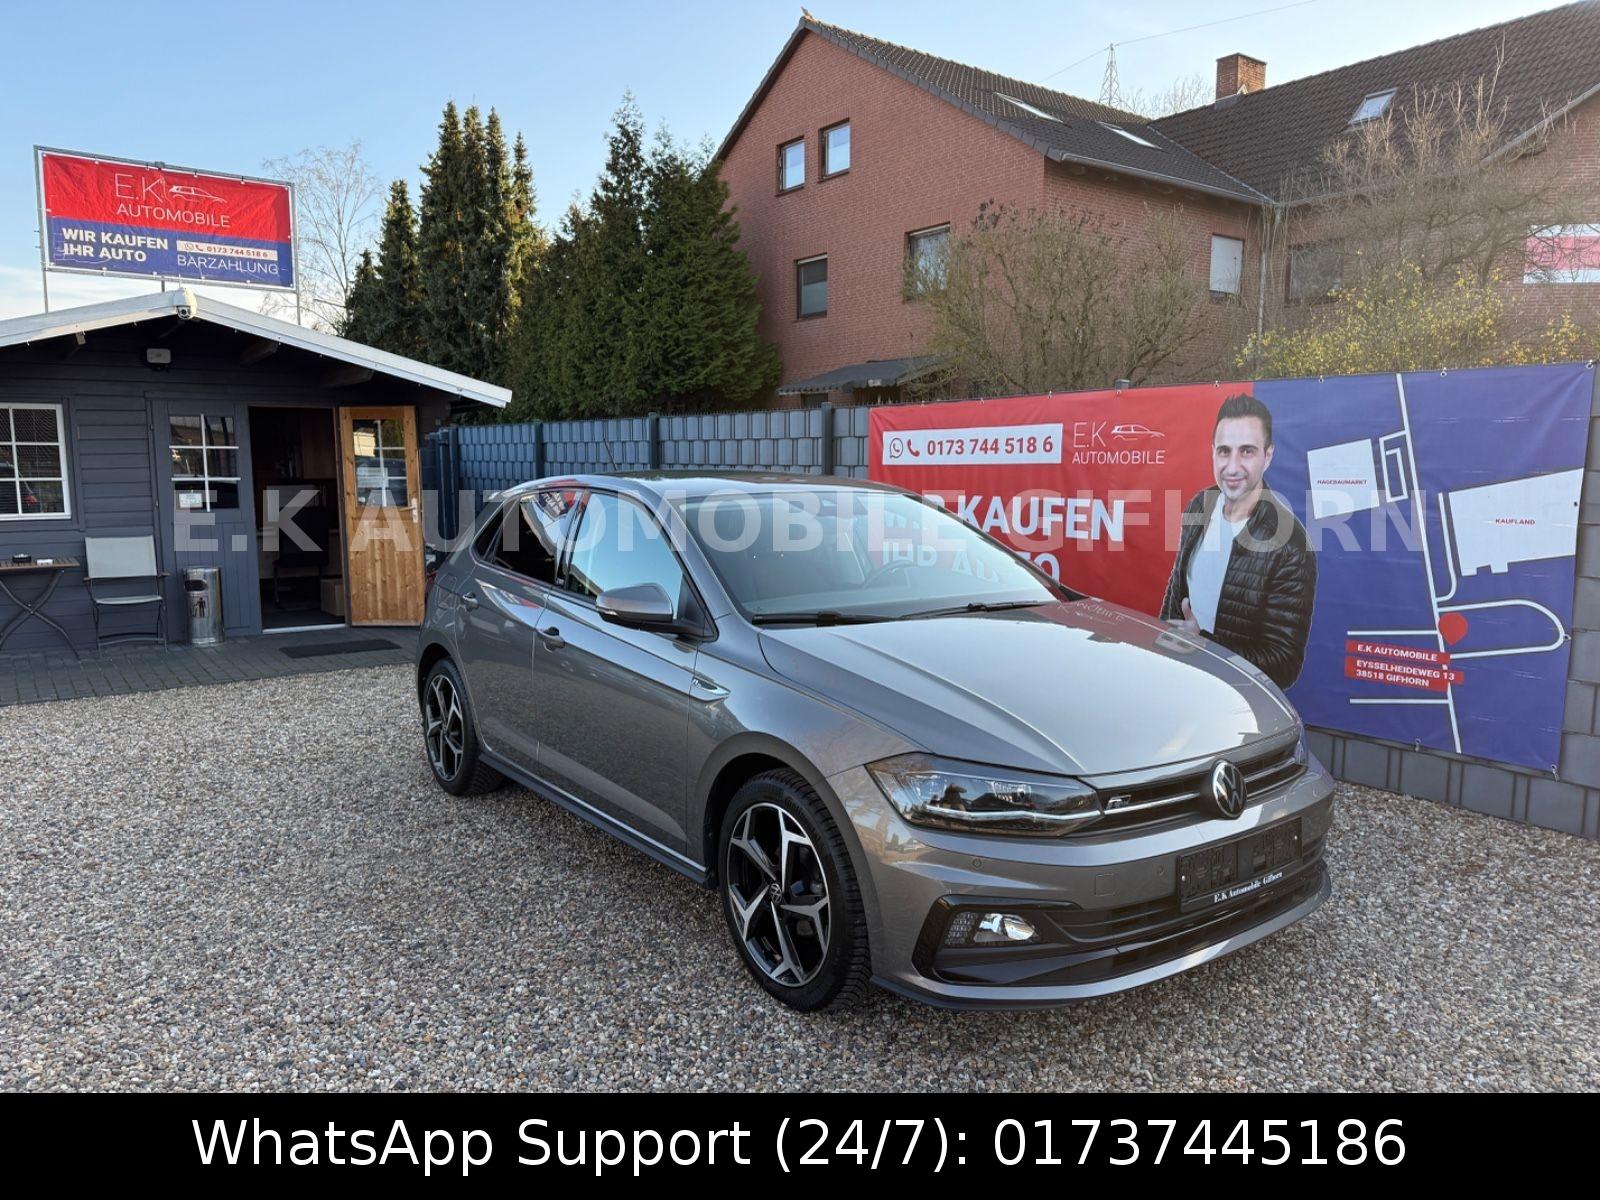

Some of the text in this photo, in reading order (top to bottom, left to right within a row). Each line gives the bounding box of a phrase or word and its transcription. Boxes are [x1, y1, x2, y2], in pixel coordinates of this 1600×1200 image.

[114, 173, 164, 203] E.K
[116, 203, 231, 228] AUTOMOBILE
[62, 228, 168, 250] WIR KAUFEN
[63, 243, 147, 262] IHR AUTO
[206, 246, 227, 254] 0173
[229, 248, 247, 256] 744
[247, 249, 261, 257] 518
[177, 254, 279, 275] BARZAHLUNG
[1073, 421, 1106, 448] E.K
[927, 435, 1053, 456] 0173 744 518 6
[1072, 450, 1165, 465] AUTOMOBILE
[957, 495, 1124, 542] KAUFEN
[1357, 644, 1438, 662] E.K AUTOMOBILE
[1356, 660, 1455, 681] EYSSELHEIDEWEG 13
[1356, 669, 1430, 687] 38518 GIFHORN
[1228, 880, 1261, 898] Automobile
